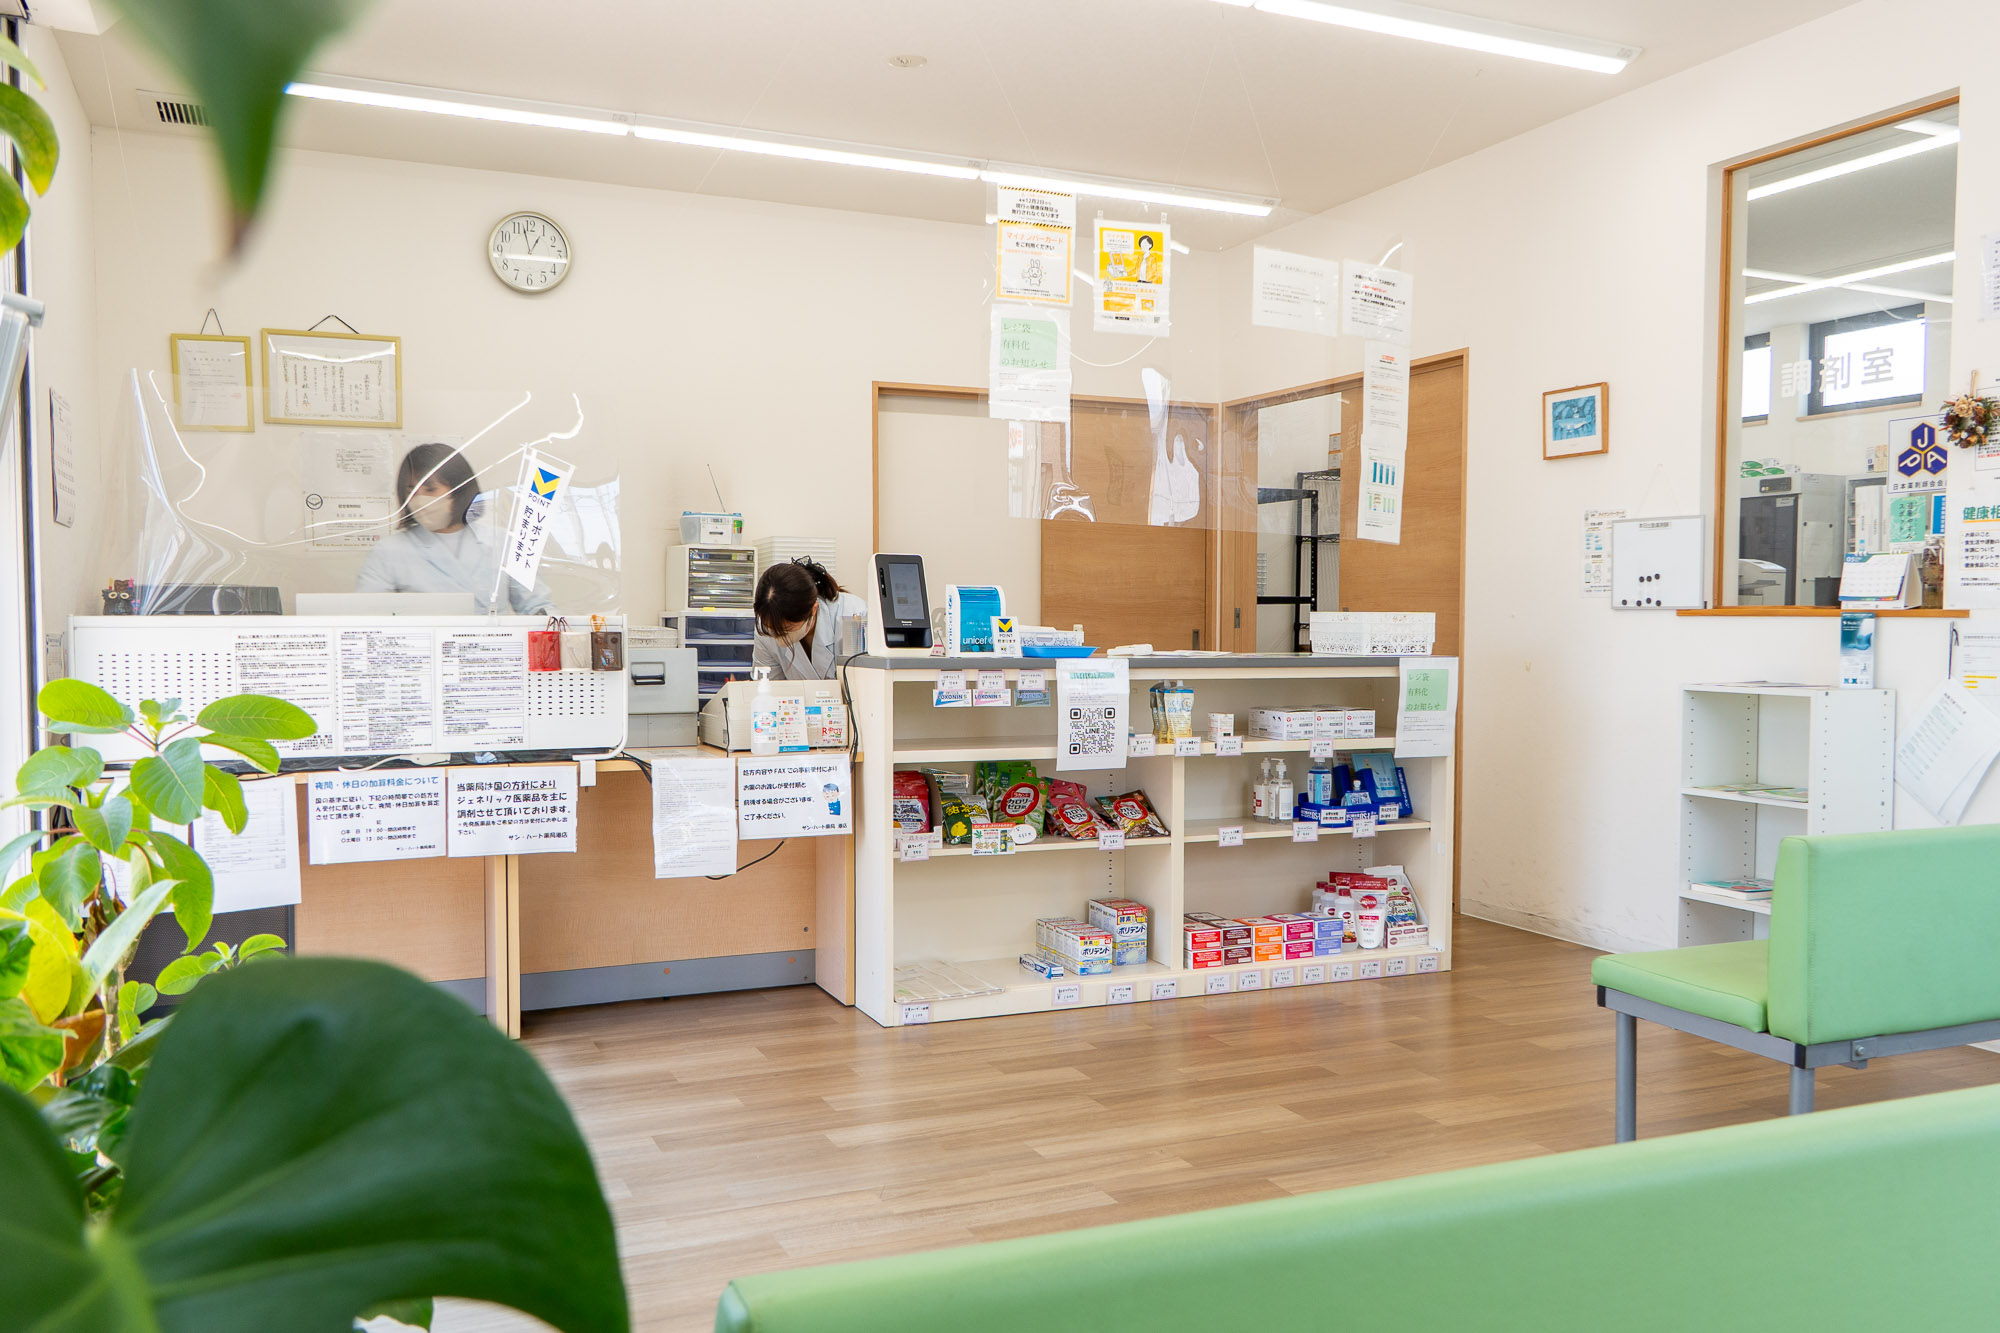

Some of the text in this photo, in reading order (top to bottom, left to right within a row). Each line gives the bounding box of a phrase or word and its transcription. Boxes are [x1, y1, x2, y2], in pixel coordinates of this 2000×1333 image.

[513, 222, 521, 234] 11
[526, 220, 536, 232] 12
[542, 224, 546, 236] 1
[500, 230, 510, 244] 10
[550, 236, 556, 248] 2
[496, 244, 504, 256] 9
[502, 258, 508, 272] 8
[550, 263, 556, 276] 4
[514, 268, 520, 281] 7
[526, 274, 533, 286] 6
[540, 271, 547, 284] 5
[1003, 323, 1032, 334] レジ袋
[1002, 339, 1031, 351] 有料化
[1001, 358, 1048, 368] のお知らせ
[1780, 347, 1894, 398] 調剤室
[528, 492, 552, 508] POINT
[516, 505, 534, 562] 貯まります
[524, 512, 546, 568] Vポイント
[962, 636, 988, 644] unicef
[1409, 672, 1430, 682] レジ袋
[1408, 688, 1428, 697] 有料化
[1406, 702, 1440, 711] のお知らせ
[315, 776, 439, 790] 夜間・休日の加算料金について
[457, 780, 556, 792] 当薬局は国の方針により
[457, 792, 568, 804] ジェネリック医薬品を主に
[316, 812, 364, 820] させて頂きます。
[457, 805, 570, 818] 調剤させて頂いております。
[744, 812, 786, 820] ご了承ください。
[1118, 924, 1146, 935] ポリデント
[1082, 947, 1110, 956] ポリデント
